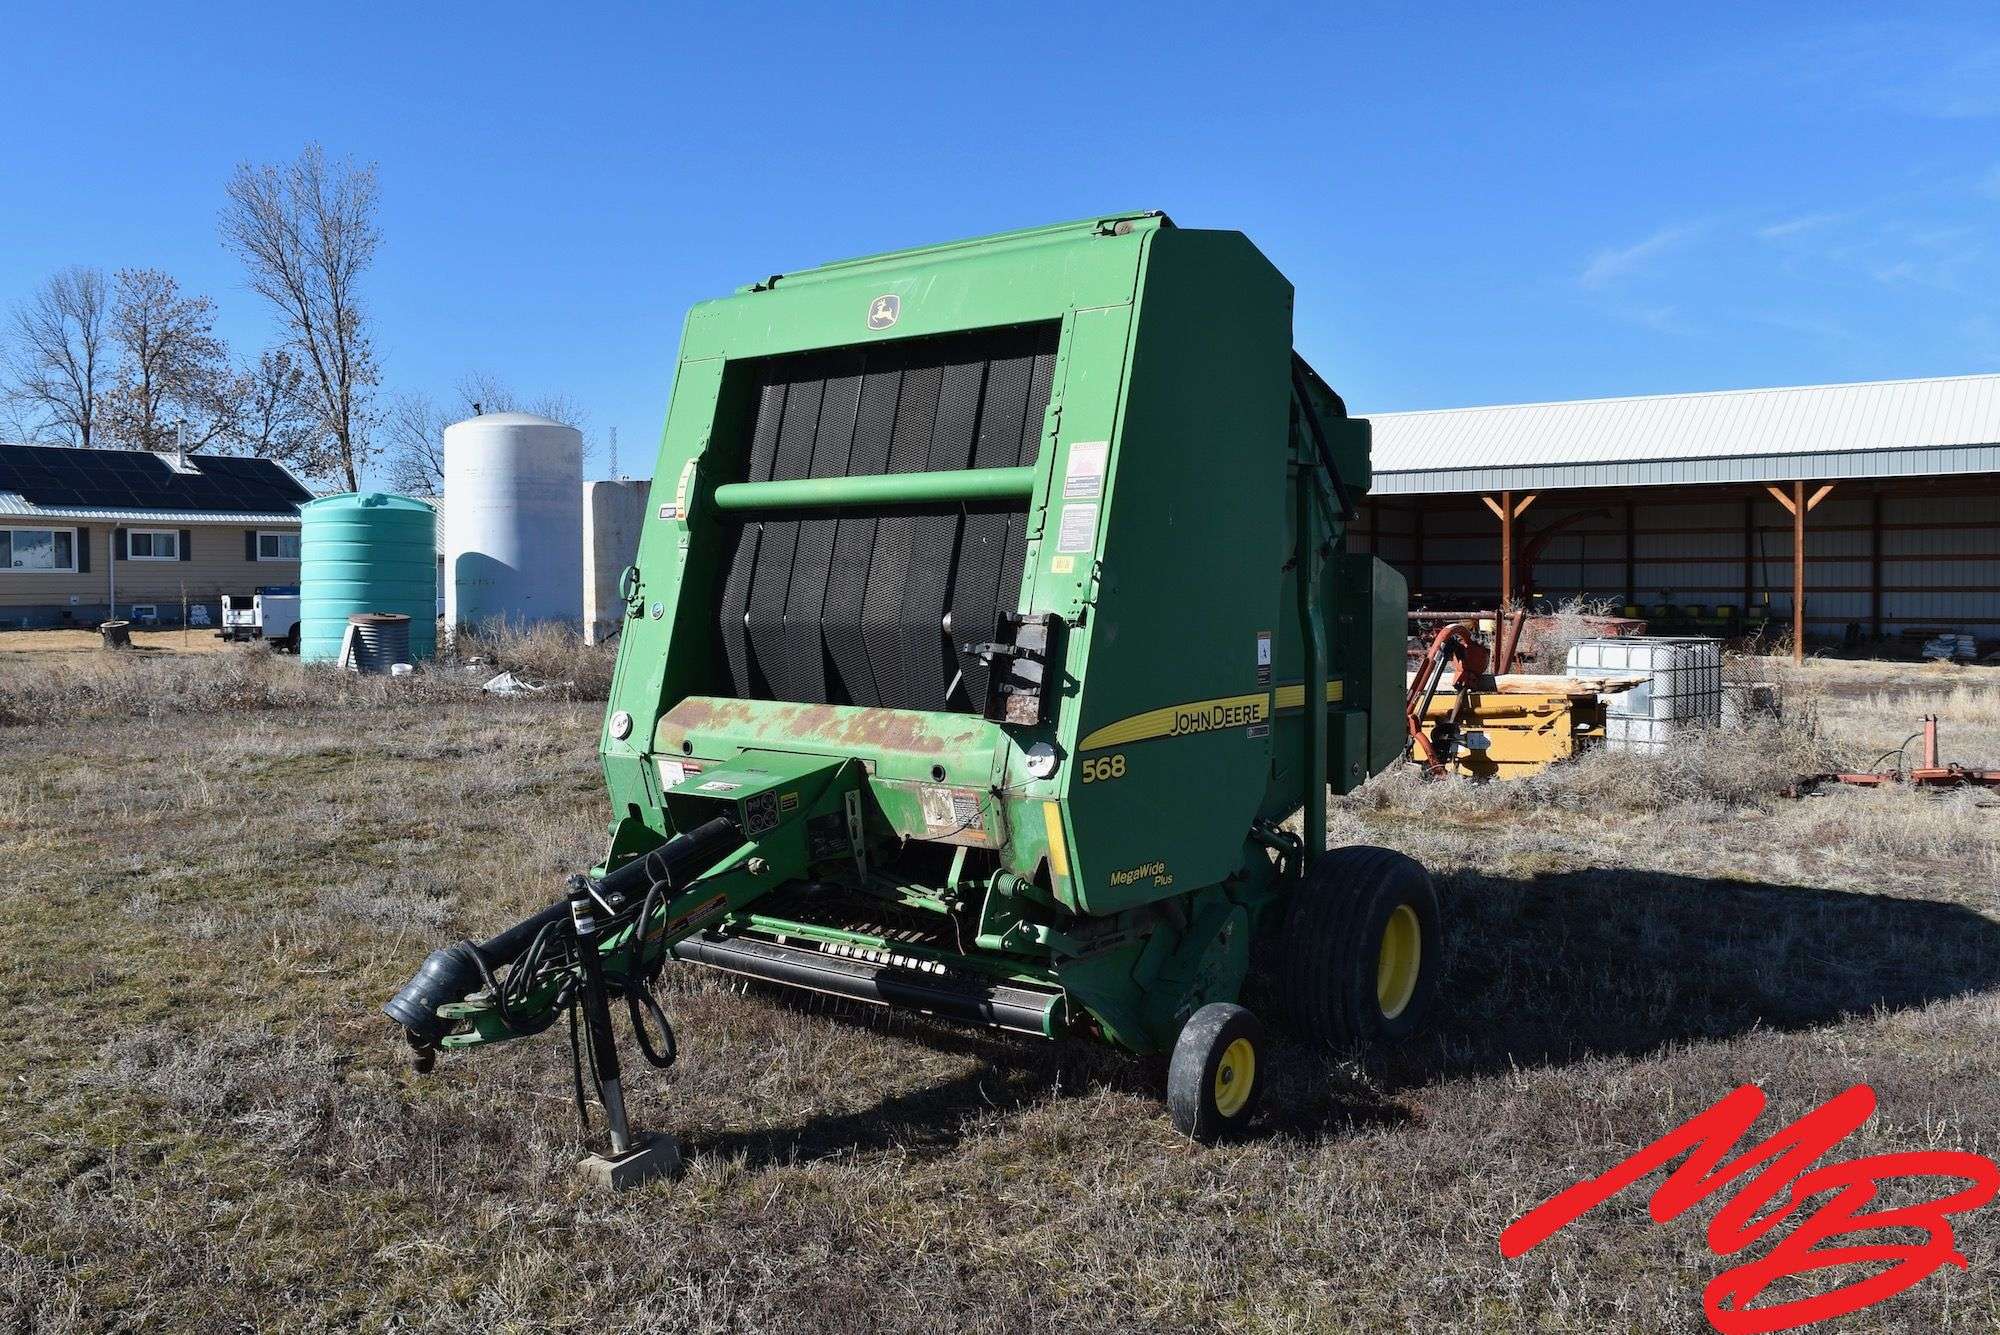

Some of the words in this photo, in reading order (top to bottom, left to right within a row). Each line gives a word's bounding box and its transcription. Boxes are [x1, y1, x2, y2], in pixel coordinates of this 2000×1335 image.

[1169, 710, 1211, 734] JOHN
[1213, 703, 1261, 727] DEERE
[1082, 754, 1126, 784] 568
[1110, 861, 1165, 886] MegaWide
[1153, 874, 1173, 887] Plus
